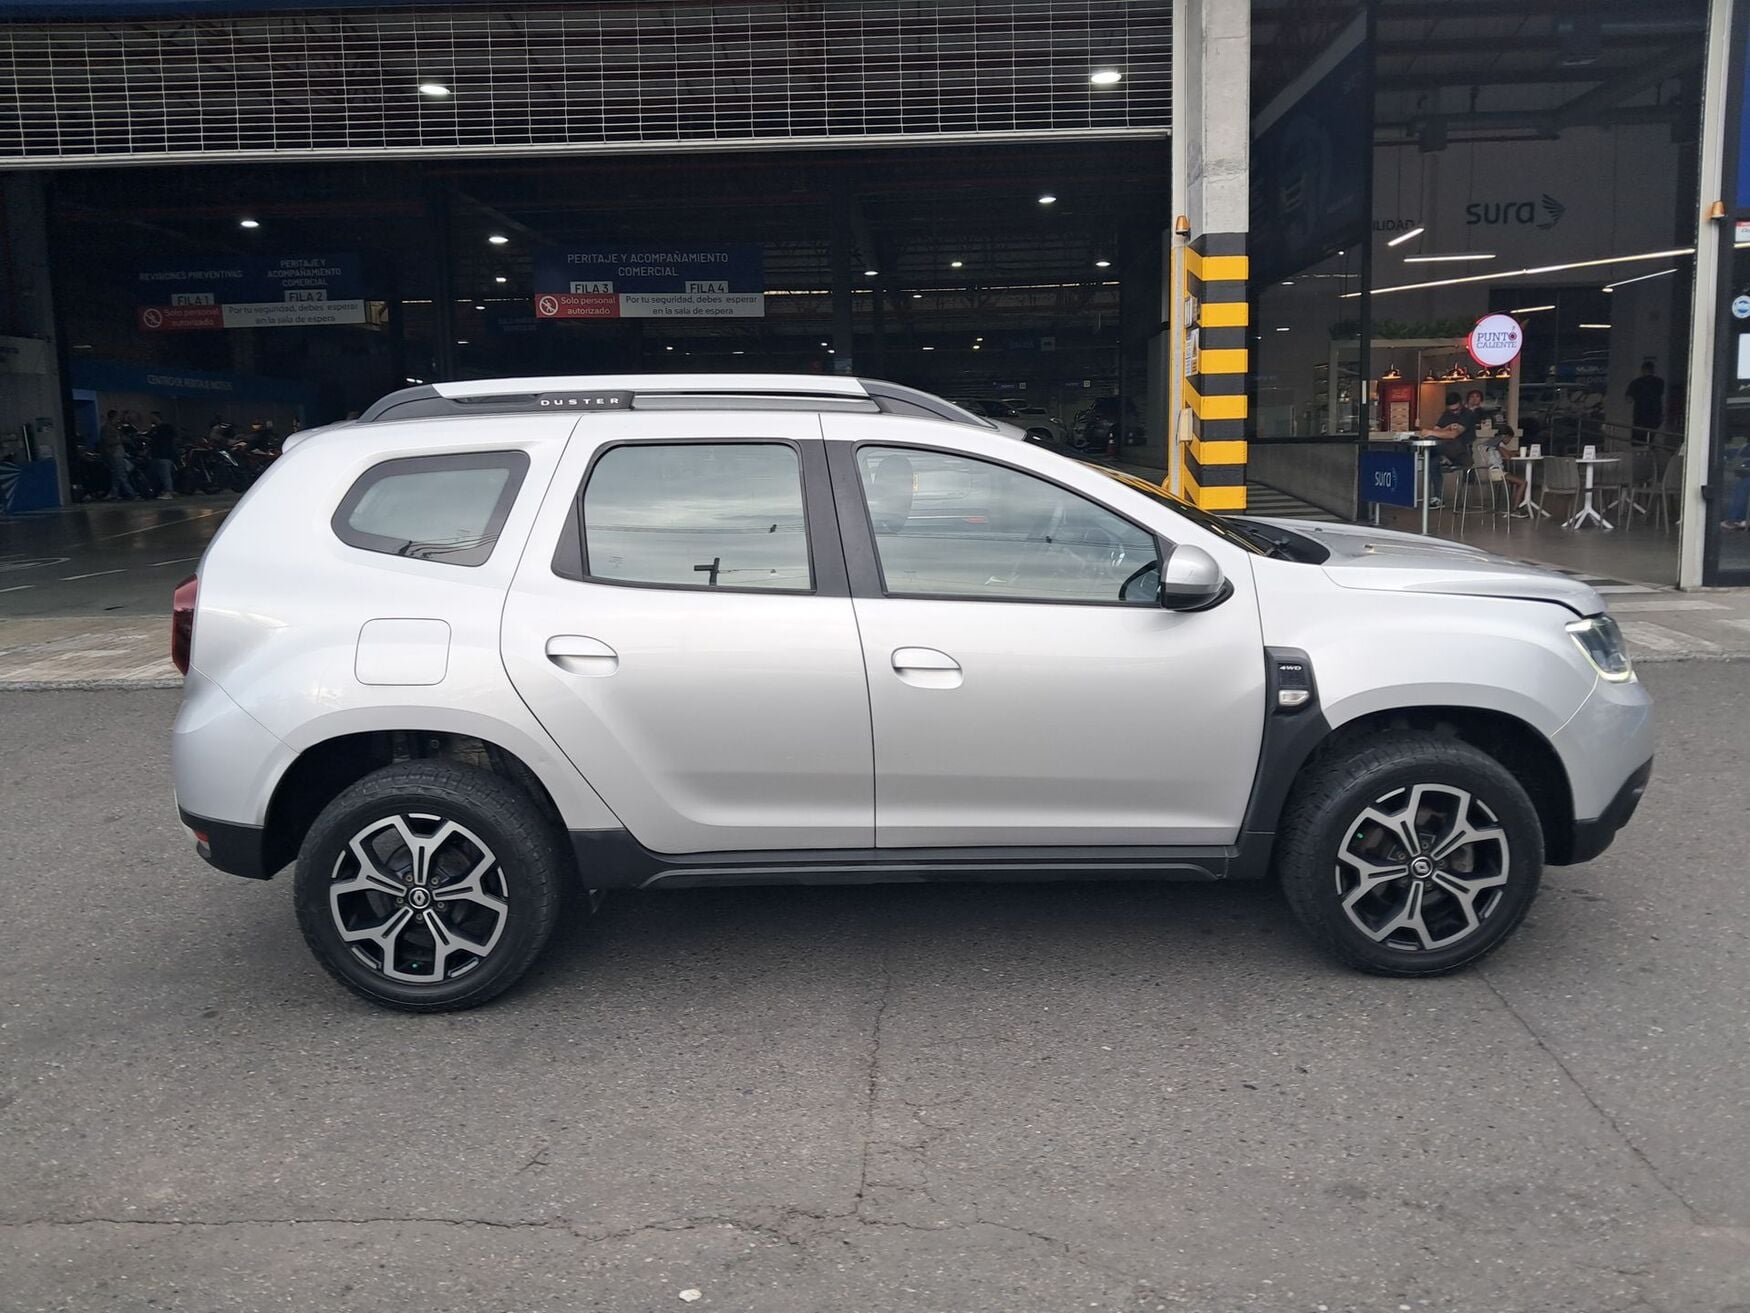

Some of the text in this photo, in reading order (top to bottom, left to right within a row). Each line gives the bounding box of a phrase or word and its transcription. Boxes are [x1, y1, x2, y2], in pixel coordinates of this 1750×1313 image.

[1466, 201, 1537, 227] sura
[567, 251, 729, 264] PERITAJE Y ACOMPAÑAMIENTO
[618, 266, 679, 277] COMERCIAL
[575, 283, 609, 294] FILA 3
[690, 283, 725, 294] FILA 4
[177, 295, 202, 305] FILA
[289, 292, 323, 302] FILA 2
[560, 296, 616, 306] Solo personal
[626, 295, 640, 304] Por
[641, 296, 650, 304] tu
[696, 295, 722, 304] debes
[726, 296, 758, 305] esperar
[567, 307, 611, 315] autorizado
[665, 307, 673, 315] la
[674, 307, 691, 315] sala
[692, 307, 704, 315] de
[705, 308, 734, 317] espera
[1477, 331, 1518, 342] PUNTO
[1476, 341, 1518, 349] CALIENTE
[540, 397, 619, 406] DUSTER
[1375, 471, 1391, 487] sura
